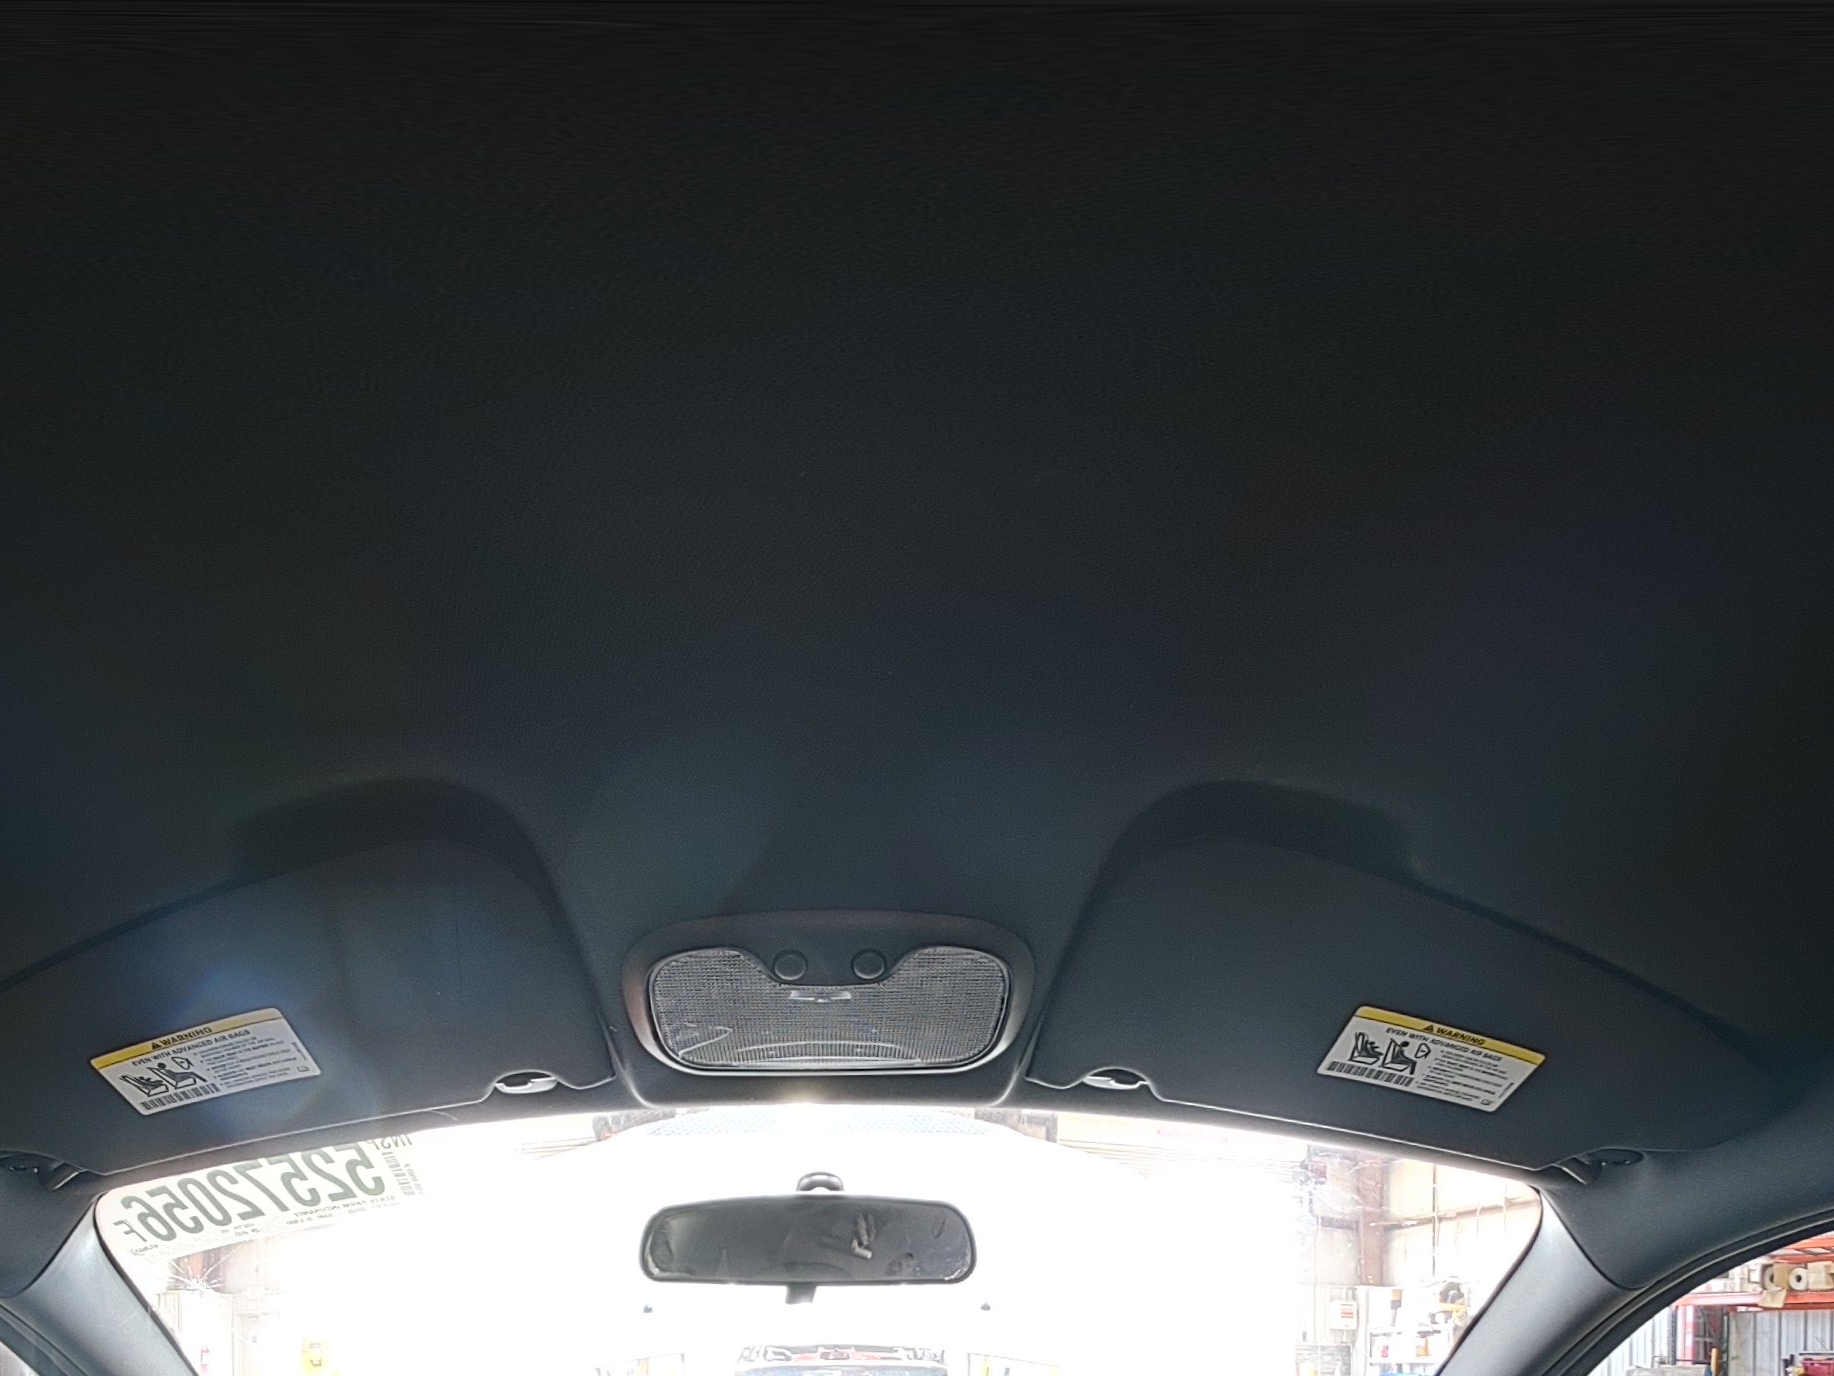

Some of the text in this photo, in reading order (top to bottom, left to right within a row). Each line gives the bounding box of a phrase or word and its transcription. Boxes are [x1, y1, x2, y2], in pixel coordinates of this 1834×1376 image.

[131, 1029, 251, 1067] EVEN WITH ADVANCED AIR BAGS
[161, 1026, 212, 1045] WARNING
[1385, 1027, 1503, 1062] EVEN WITH ADVANCED AIR BAGS
[1436, 1026, 1486, 1046] WARNING
